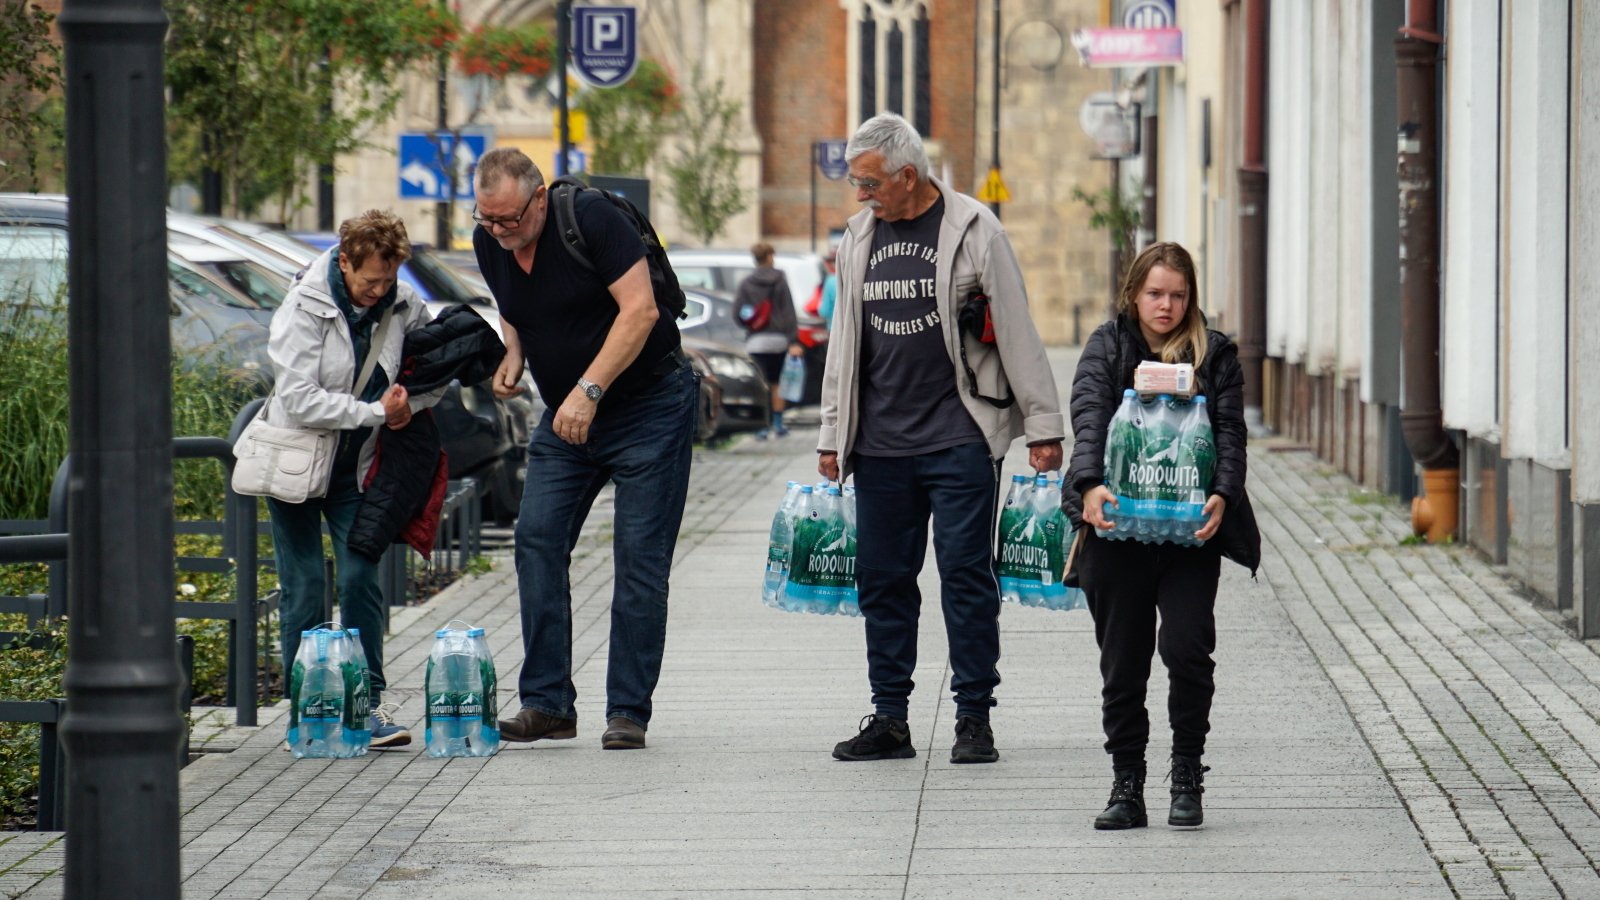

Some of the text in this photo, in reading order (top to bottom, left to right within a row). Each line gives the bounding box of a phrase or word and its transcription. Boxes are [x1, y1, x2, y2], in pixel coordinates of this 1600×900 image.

[593, 17, 618, 51] P
[870, 242, 939, 270] SOUTHWEST 193
[862, 280, 917, 301] HAMPIONS
[871, 313, 882, 331] LOS
[883, 318, 924, 335] ANGELES
[1128, 463, 1199, 487] RODOWITA
